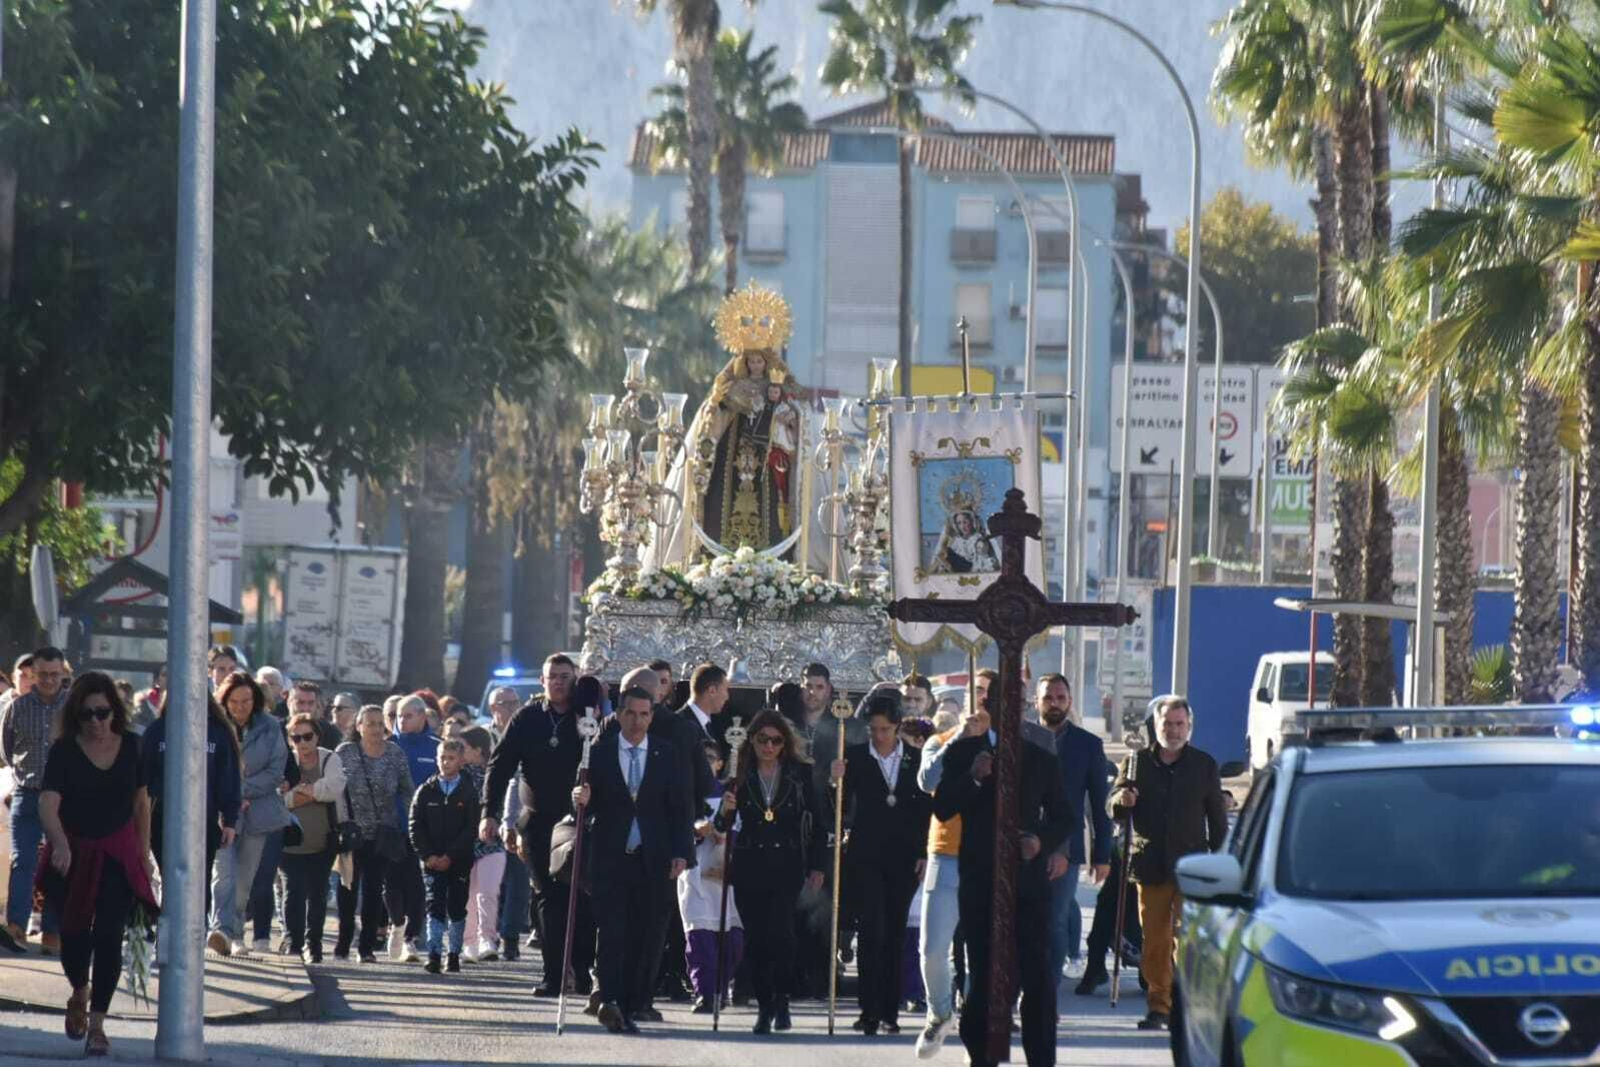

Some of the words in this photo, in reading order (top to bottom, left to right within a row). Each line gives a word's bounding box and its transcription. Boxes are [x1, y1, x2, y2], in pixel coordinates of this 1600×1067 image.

[1133, 377, 1171, 387] paseo
[1131, 391, 1179, 402] aritimo
[1204, 393, 1246, 403] cidad
[1116, 417, 1184, 428] GBRALTAR
